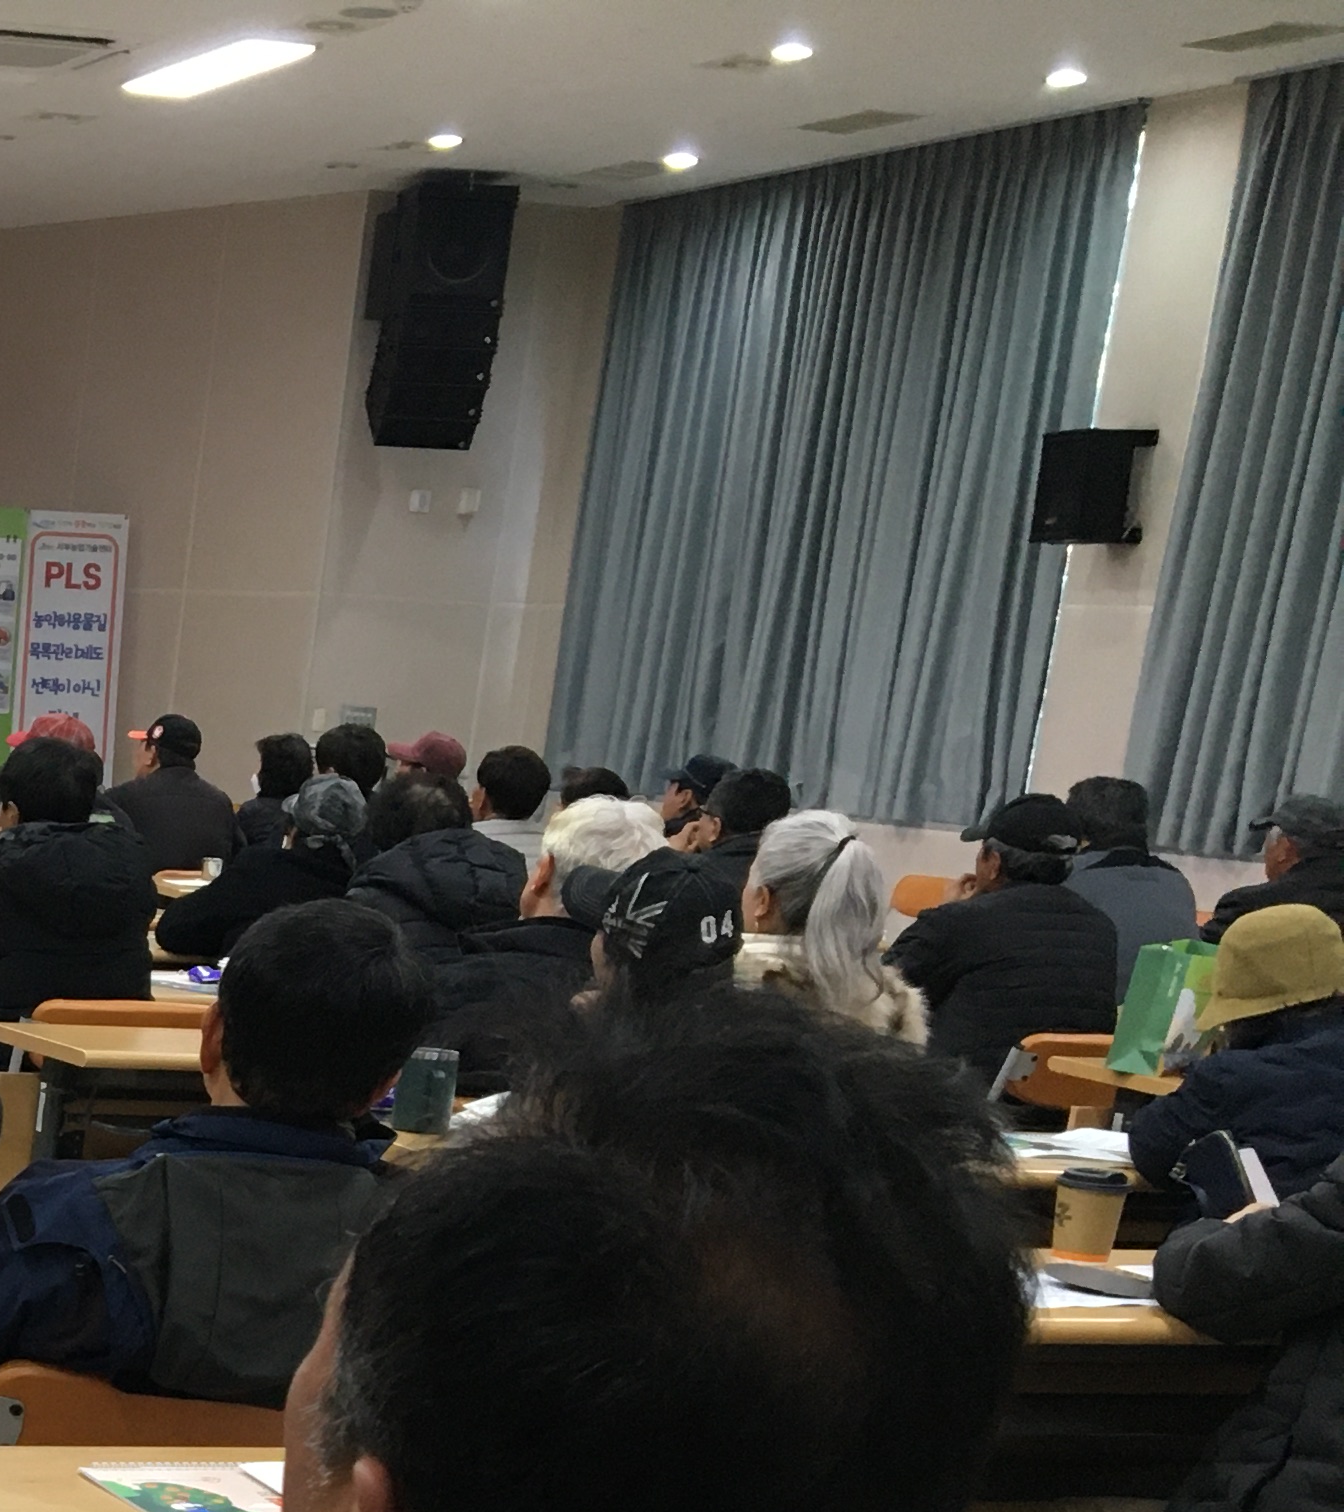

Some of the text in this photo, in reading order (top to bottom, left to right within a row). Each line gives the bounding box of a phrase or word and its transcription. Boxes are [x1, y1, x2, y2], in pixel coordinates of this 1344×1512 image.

[44, 561, 102, 590] PLS
[72, 679, 101, 697] 아닌
[701, 909, 734, 944] 04
